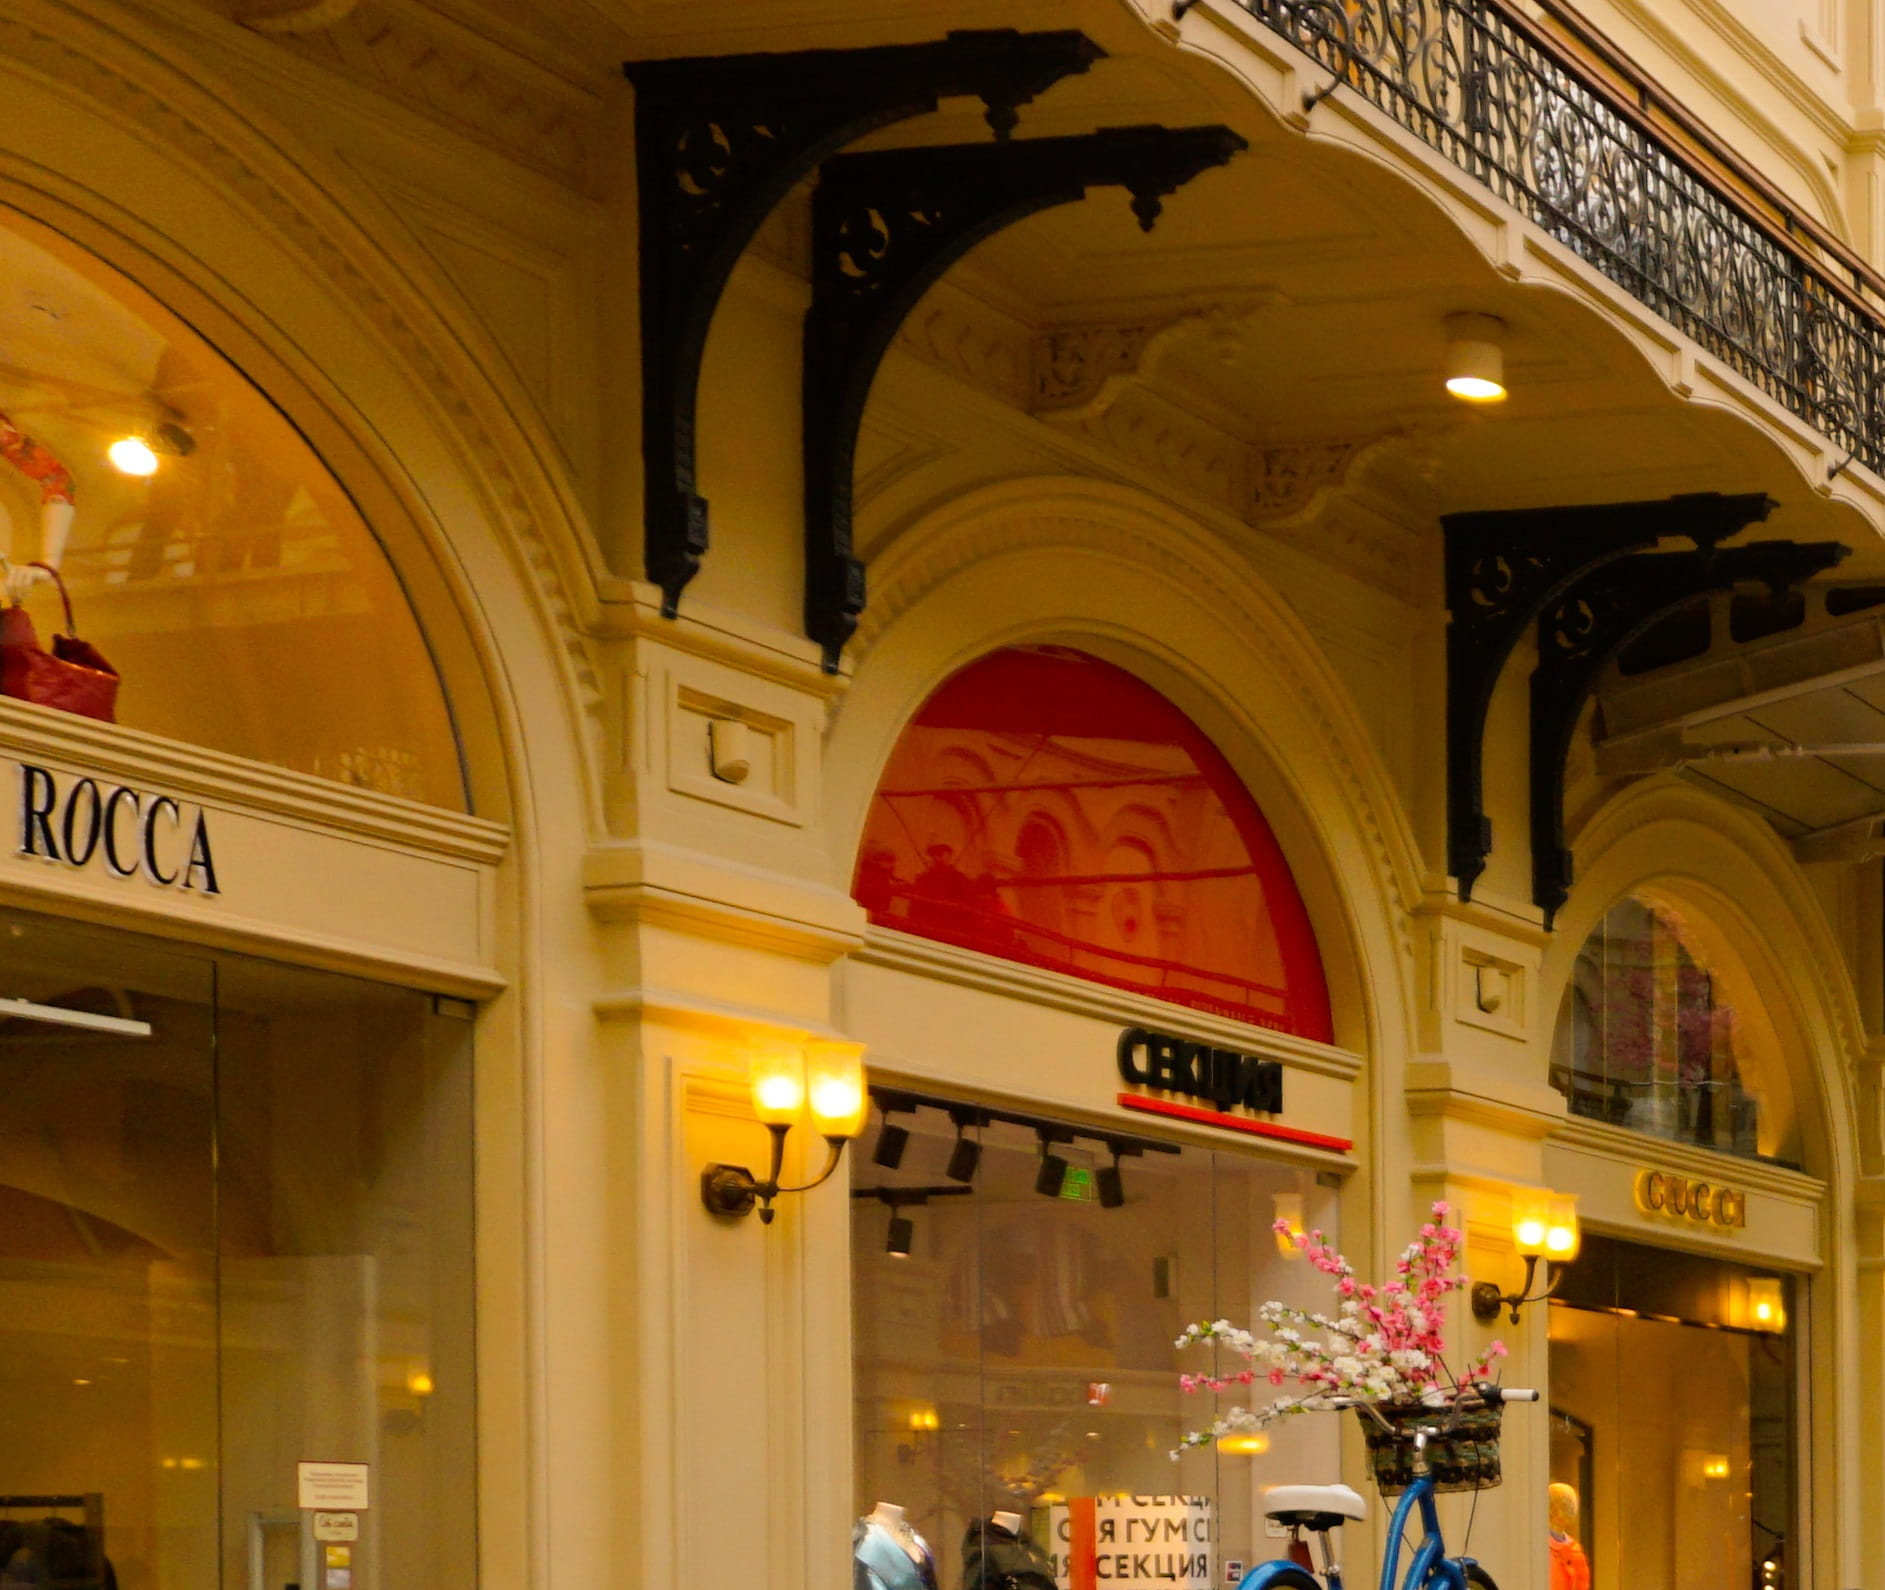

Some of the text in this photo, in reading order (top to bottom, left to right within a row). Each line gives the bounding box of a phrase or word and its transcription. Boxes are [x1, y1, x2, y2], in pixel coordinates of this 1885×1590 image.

[20, 763, 222, 895] ROCCA
[1116, 1027, 1283, 1115] СЕКЦИЯ
[1639, 1170, 1746, 1228] GUCCI
[1126, 1518, 1188, 1543] ГУМ
[1096, 1553, 1208, 1581] СЕКЦИЯ
